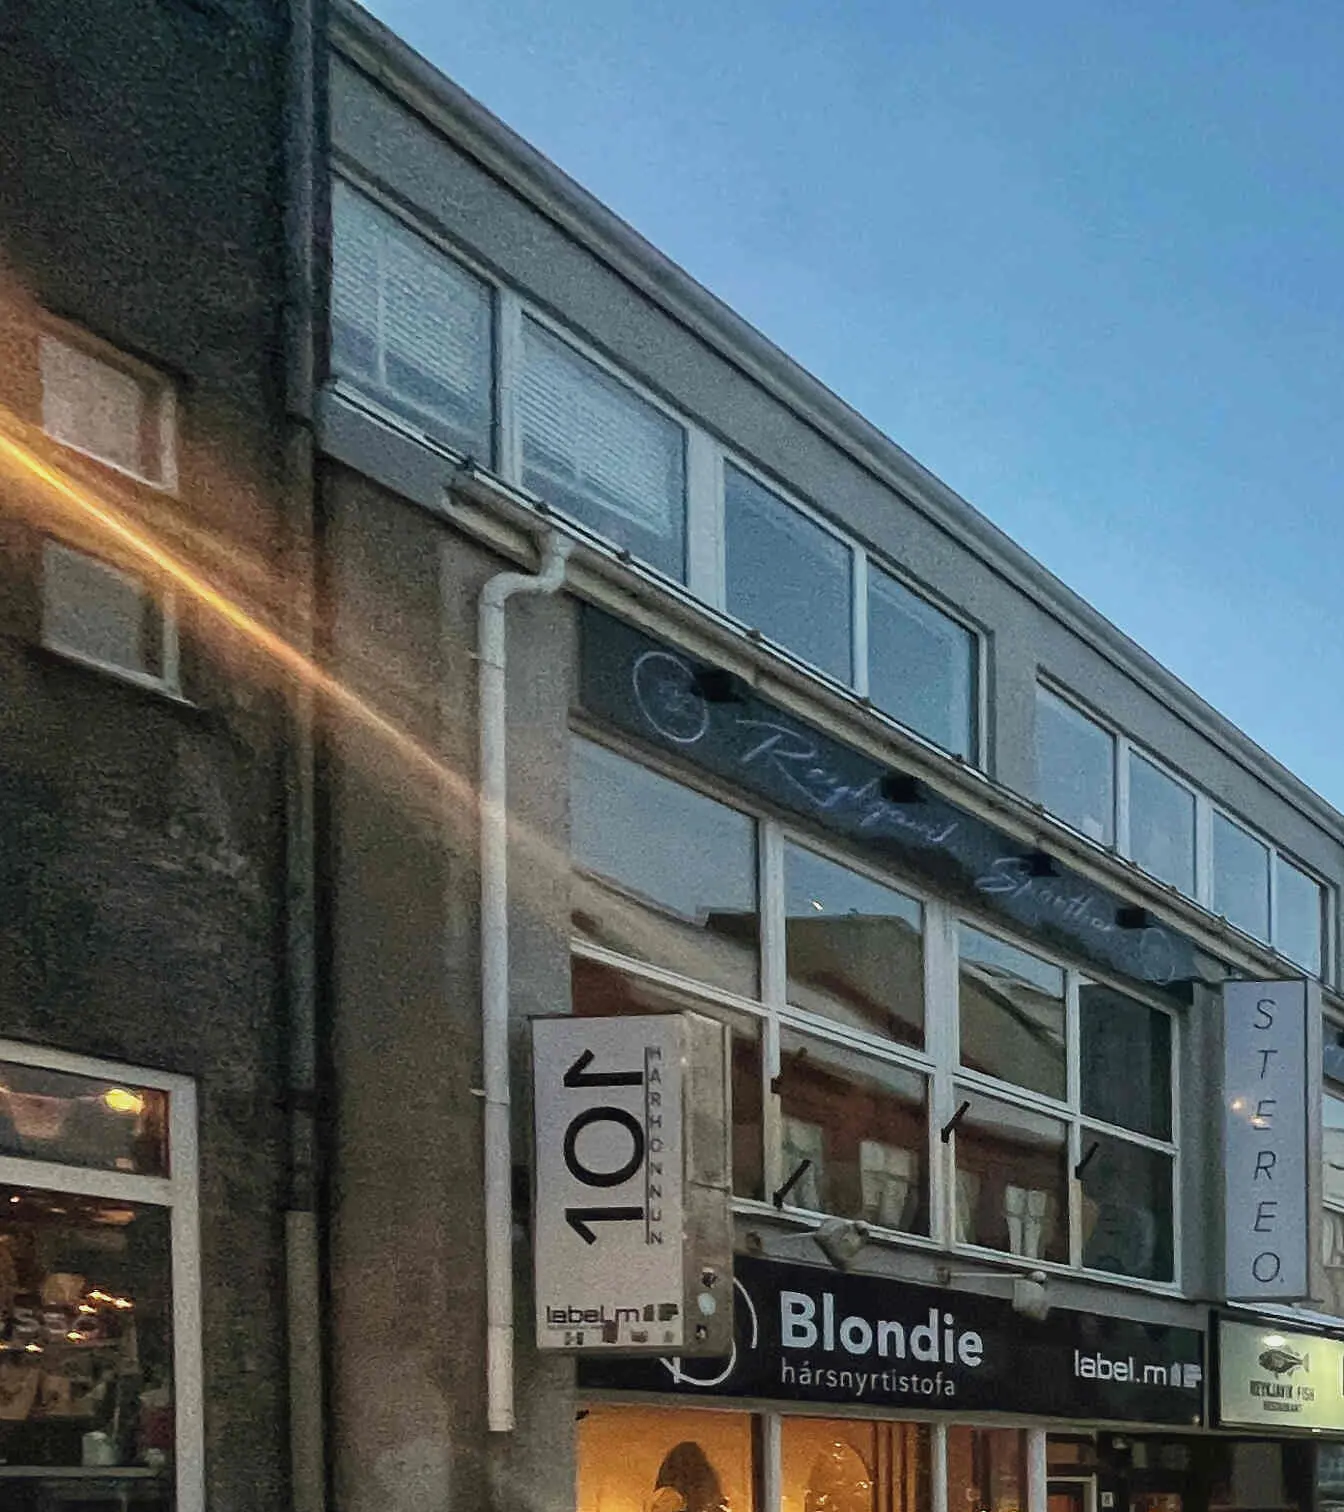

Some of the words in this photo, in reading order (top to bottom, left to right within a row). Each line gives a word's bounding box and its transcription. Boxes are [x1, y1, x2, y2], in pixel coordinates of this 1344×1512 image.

[563, 1048, 645, 1246] 101
[779, 1289, 985, 1369] Blondie
[781, 1356, 957, 1398] hársnyrtistofa
[1073, 1347, 1169, 1388] label.m
